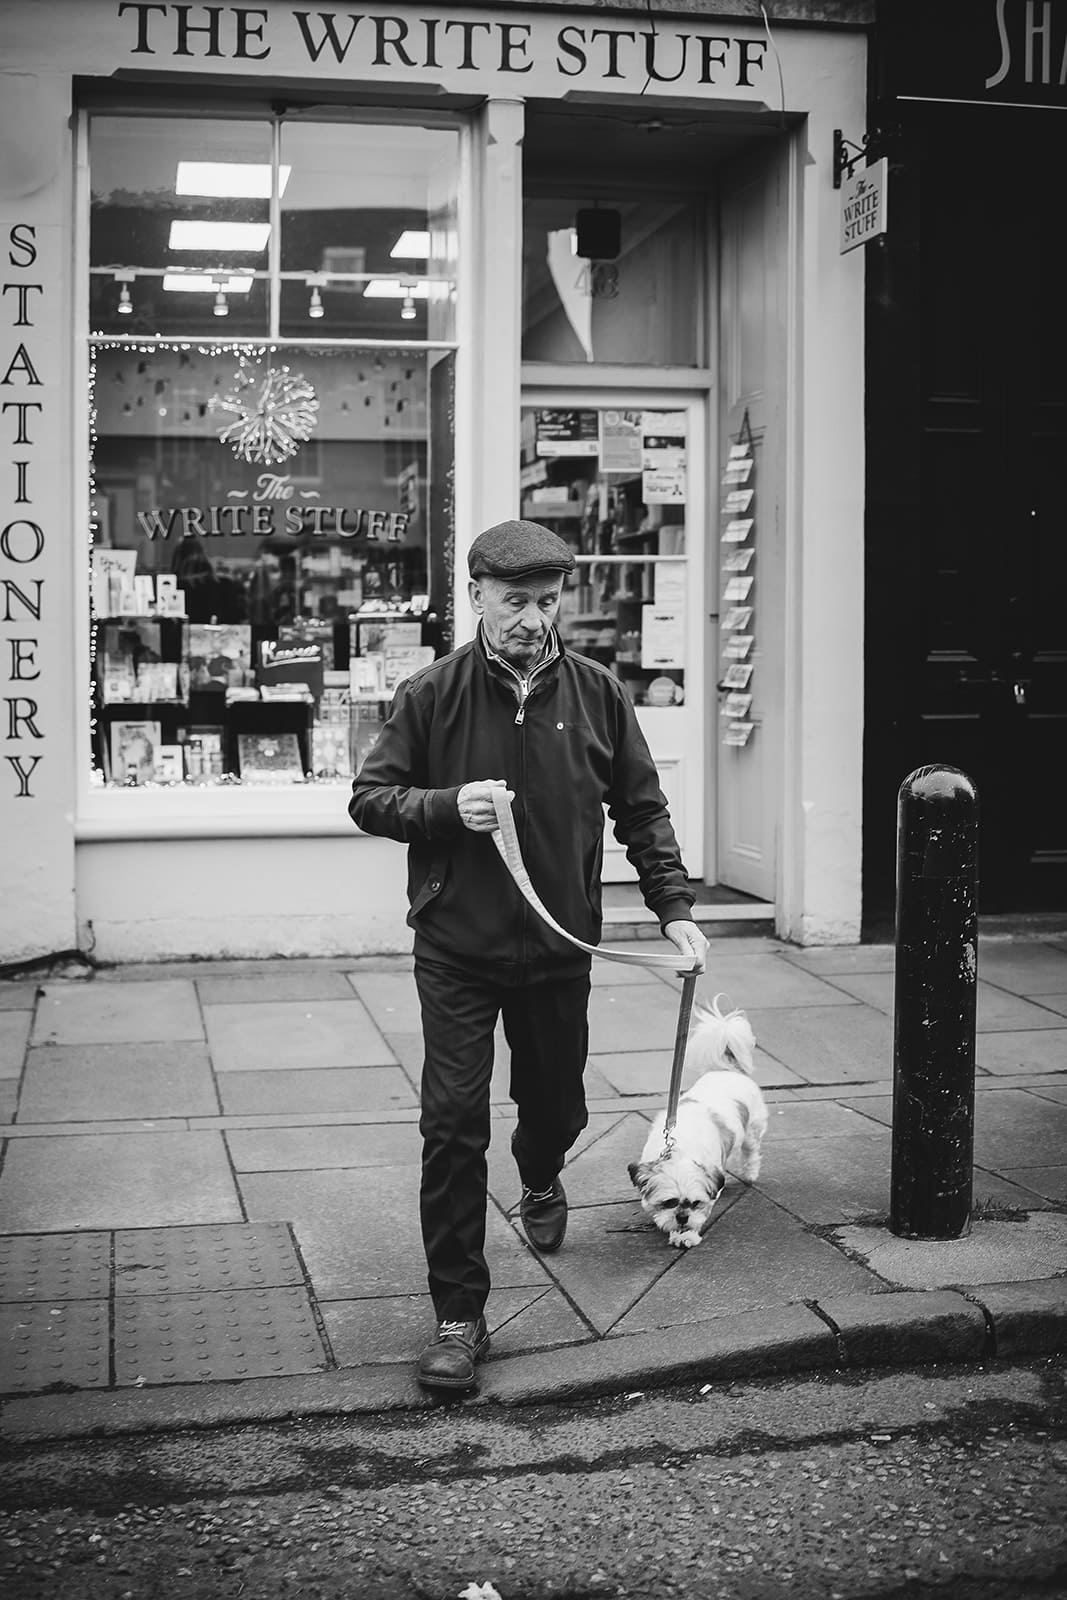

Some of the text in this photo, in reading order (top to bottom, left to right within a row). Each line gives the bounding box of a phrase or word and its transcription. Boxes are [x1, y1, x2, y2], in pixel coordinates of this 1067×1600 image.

[117, 2, 768, 87] THE WRITE STUFF
[985, 0, 1067, 89] SH
[843, 190, 879, 222] WRITE
[854, 179, 867, 199] The
[843, 210, 878, 242] STUFF
[252, 473, 296, 501] The
[0, 223, 45, 797] STATIONERY
[136, 505, 413, 543] WRITE STUFF
